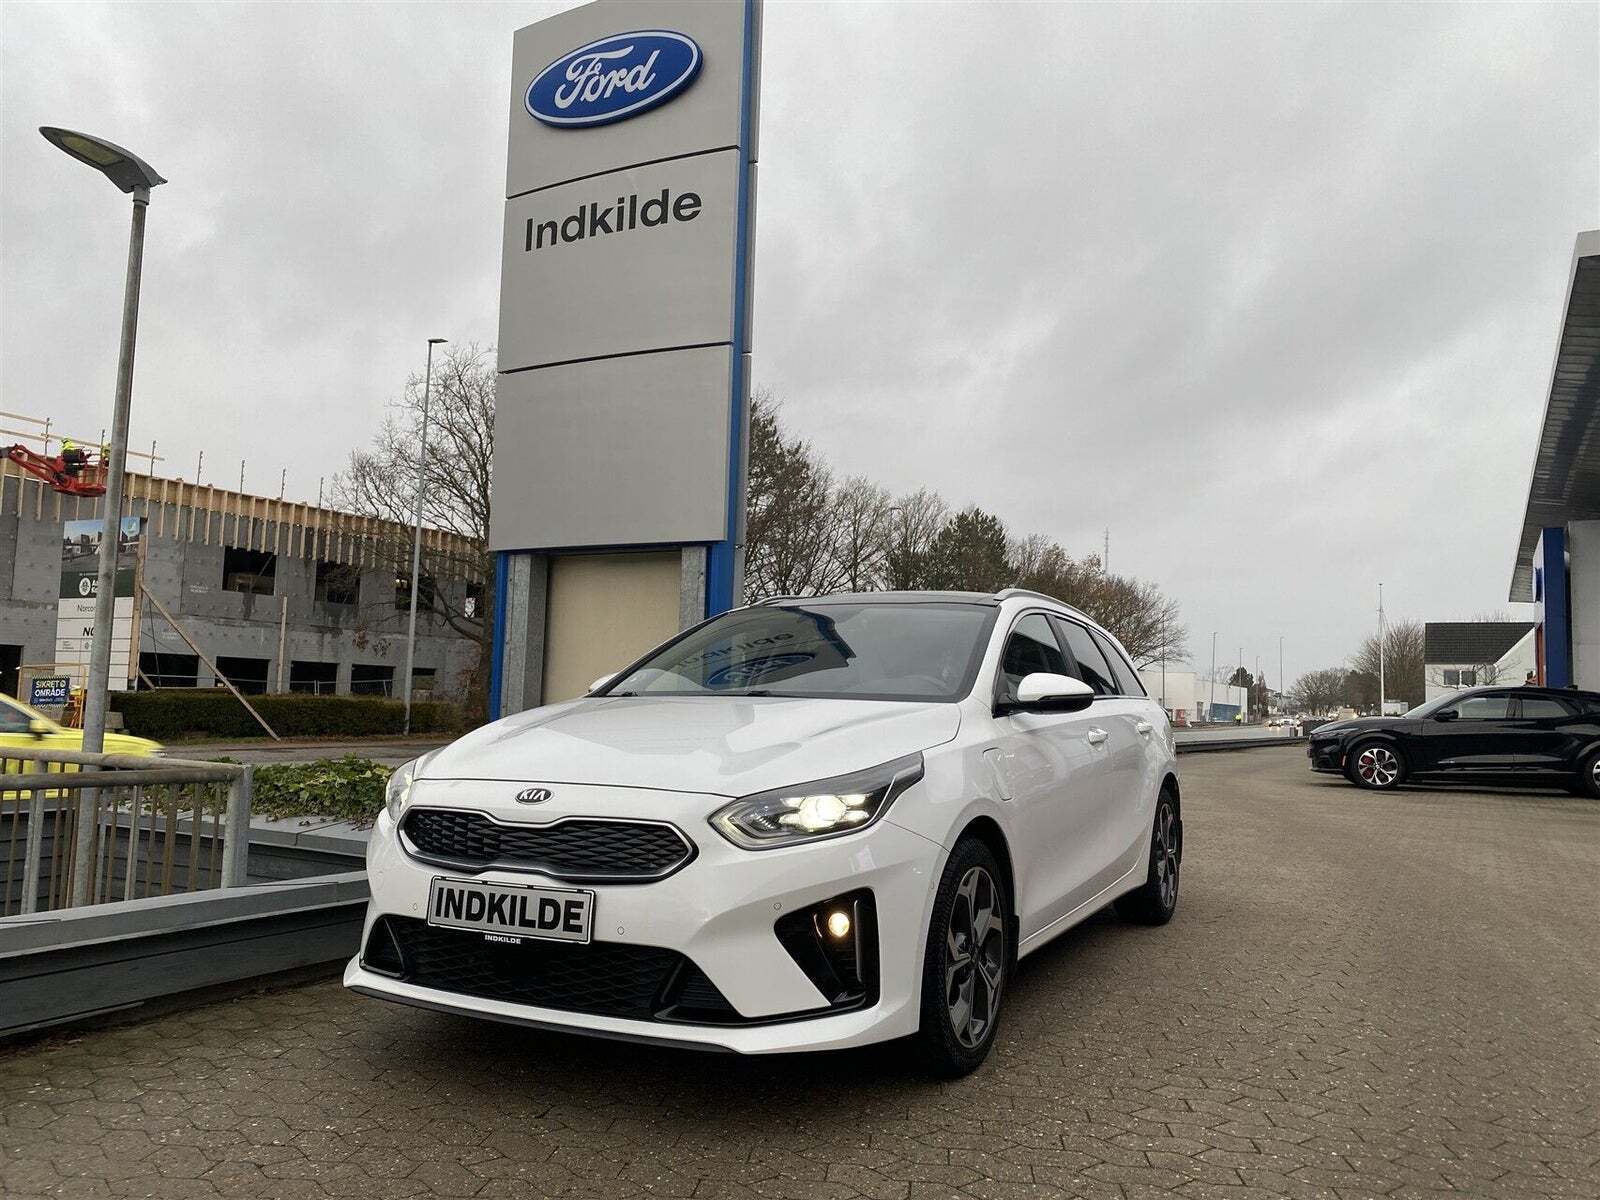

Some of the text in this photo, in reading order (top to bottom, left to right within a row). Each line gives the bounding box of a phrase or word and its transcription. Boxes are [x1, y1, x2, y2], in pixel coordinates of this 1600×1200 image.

[554, 45, 662, 109] Ford
[525, 188, 702, 252] Indkilde
[519, 789, 546, 801] KIA
[435, 887, 585, 934] INDKILDE
[484, 934, 521, 944] INDKILDE
